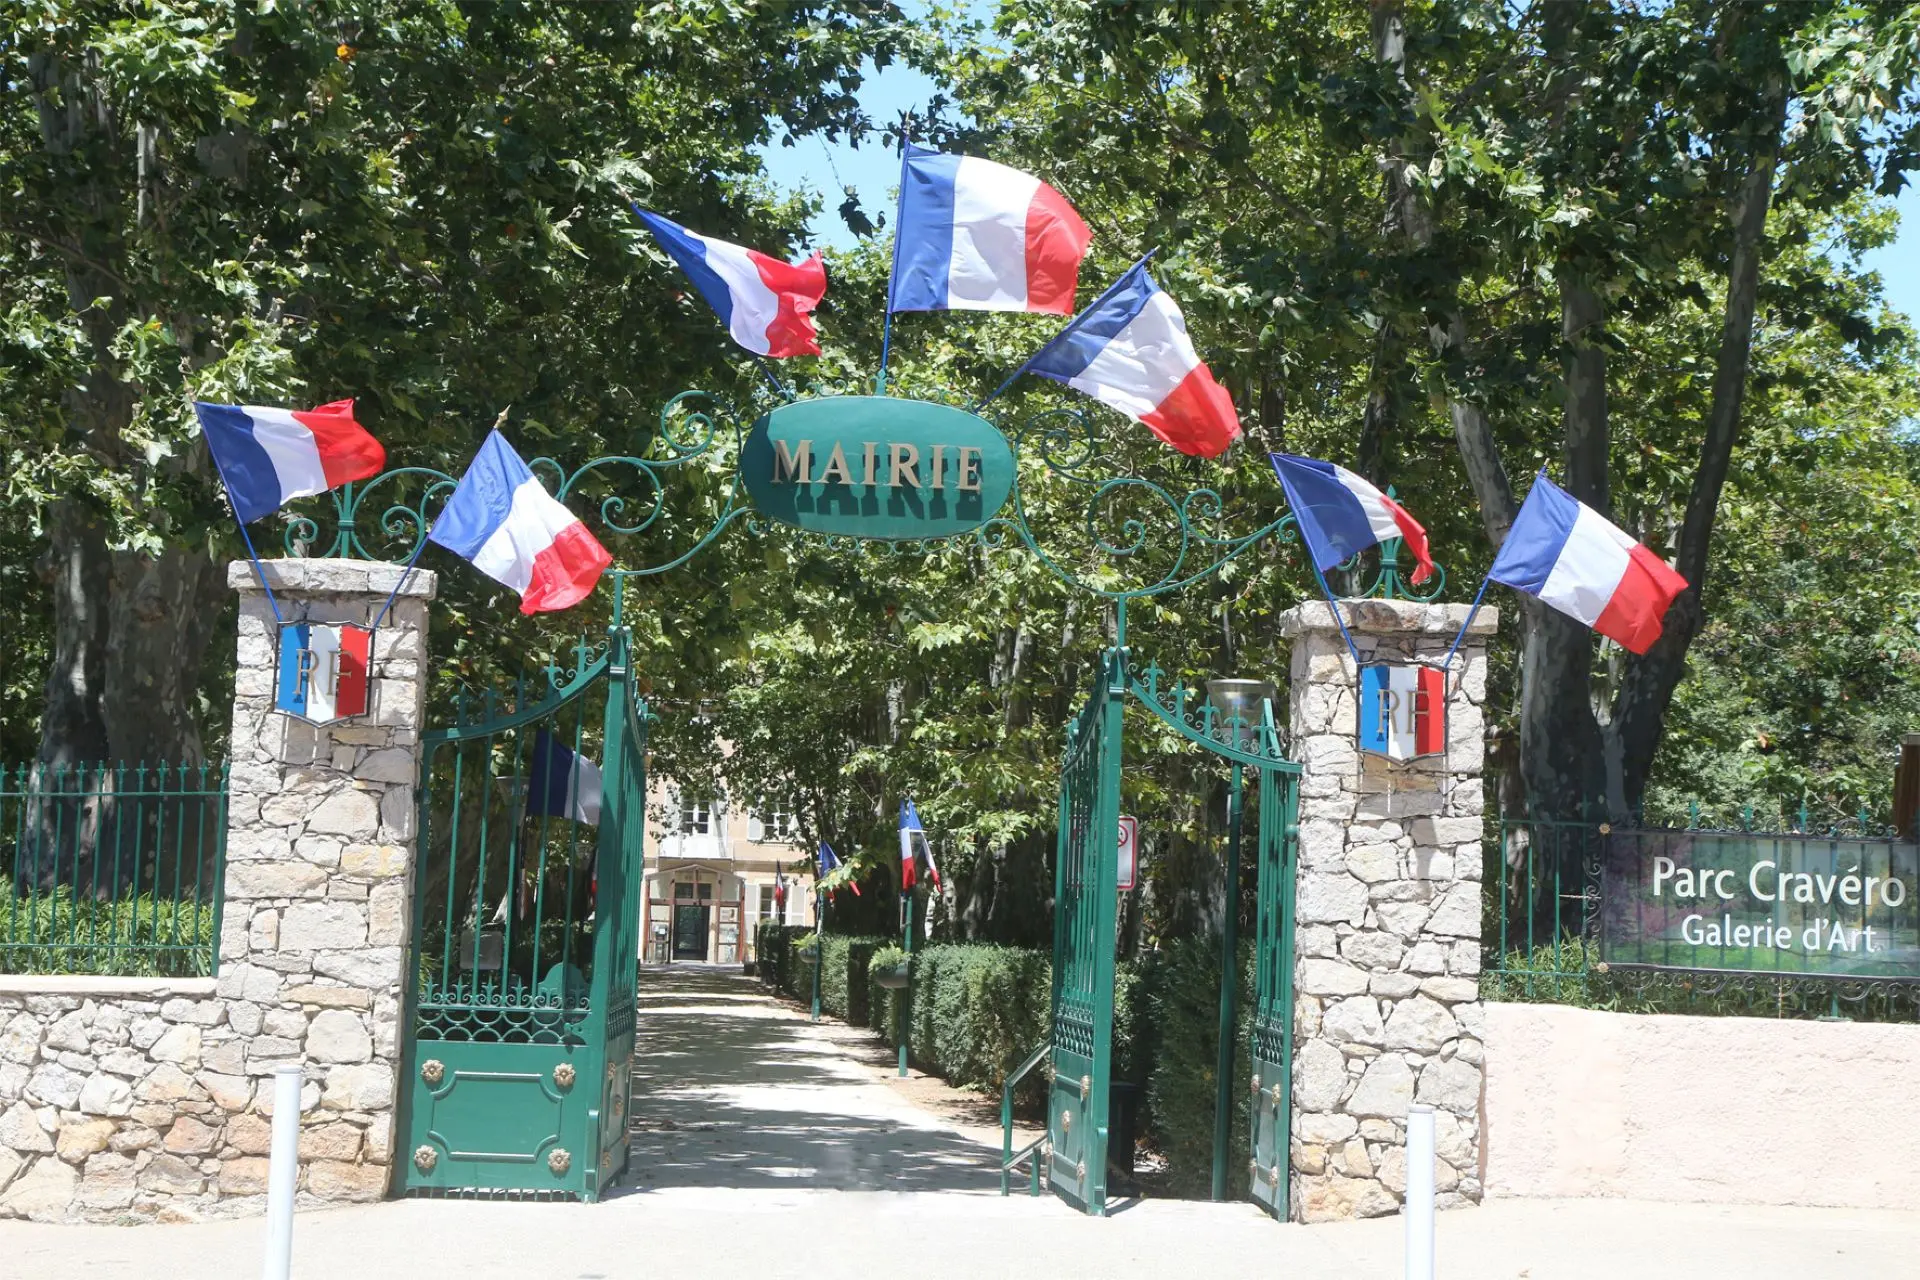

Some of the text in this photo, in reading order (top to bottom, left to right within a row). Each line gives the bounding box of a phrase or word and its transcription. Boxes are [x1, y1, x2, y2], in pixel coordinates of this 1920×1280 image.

[769, 439, 983, 491] MAIRIE
[292, 648, 353, 696] RF
[1376, 688, 1430, 735] RF
[1653, 856, 1906, 908] Parc Cravéro
[1681, 913, 1877, 953] Galerie d'Art
